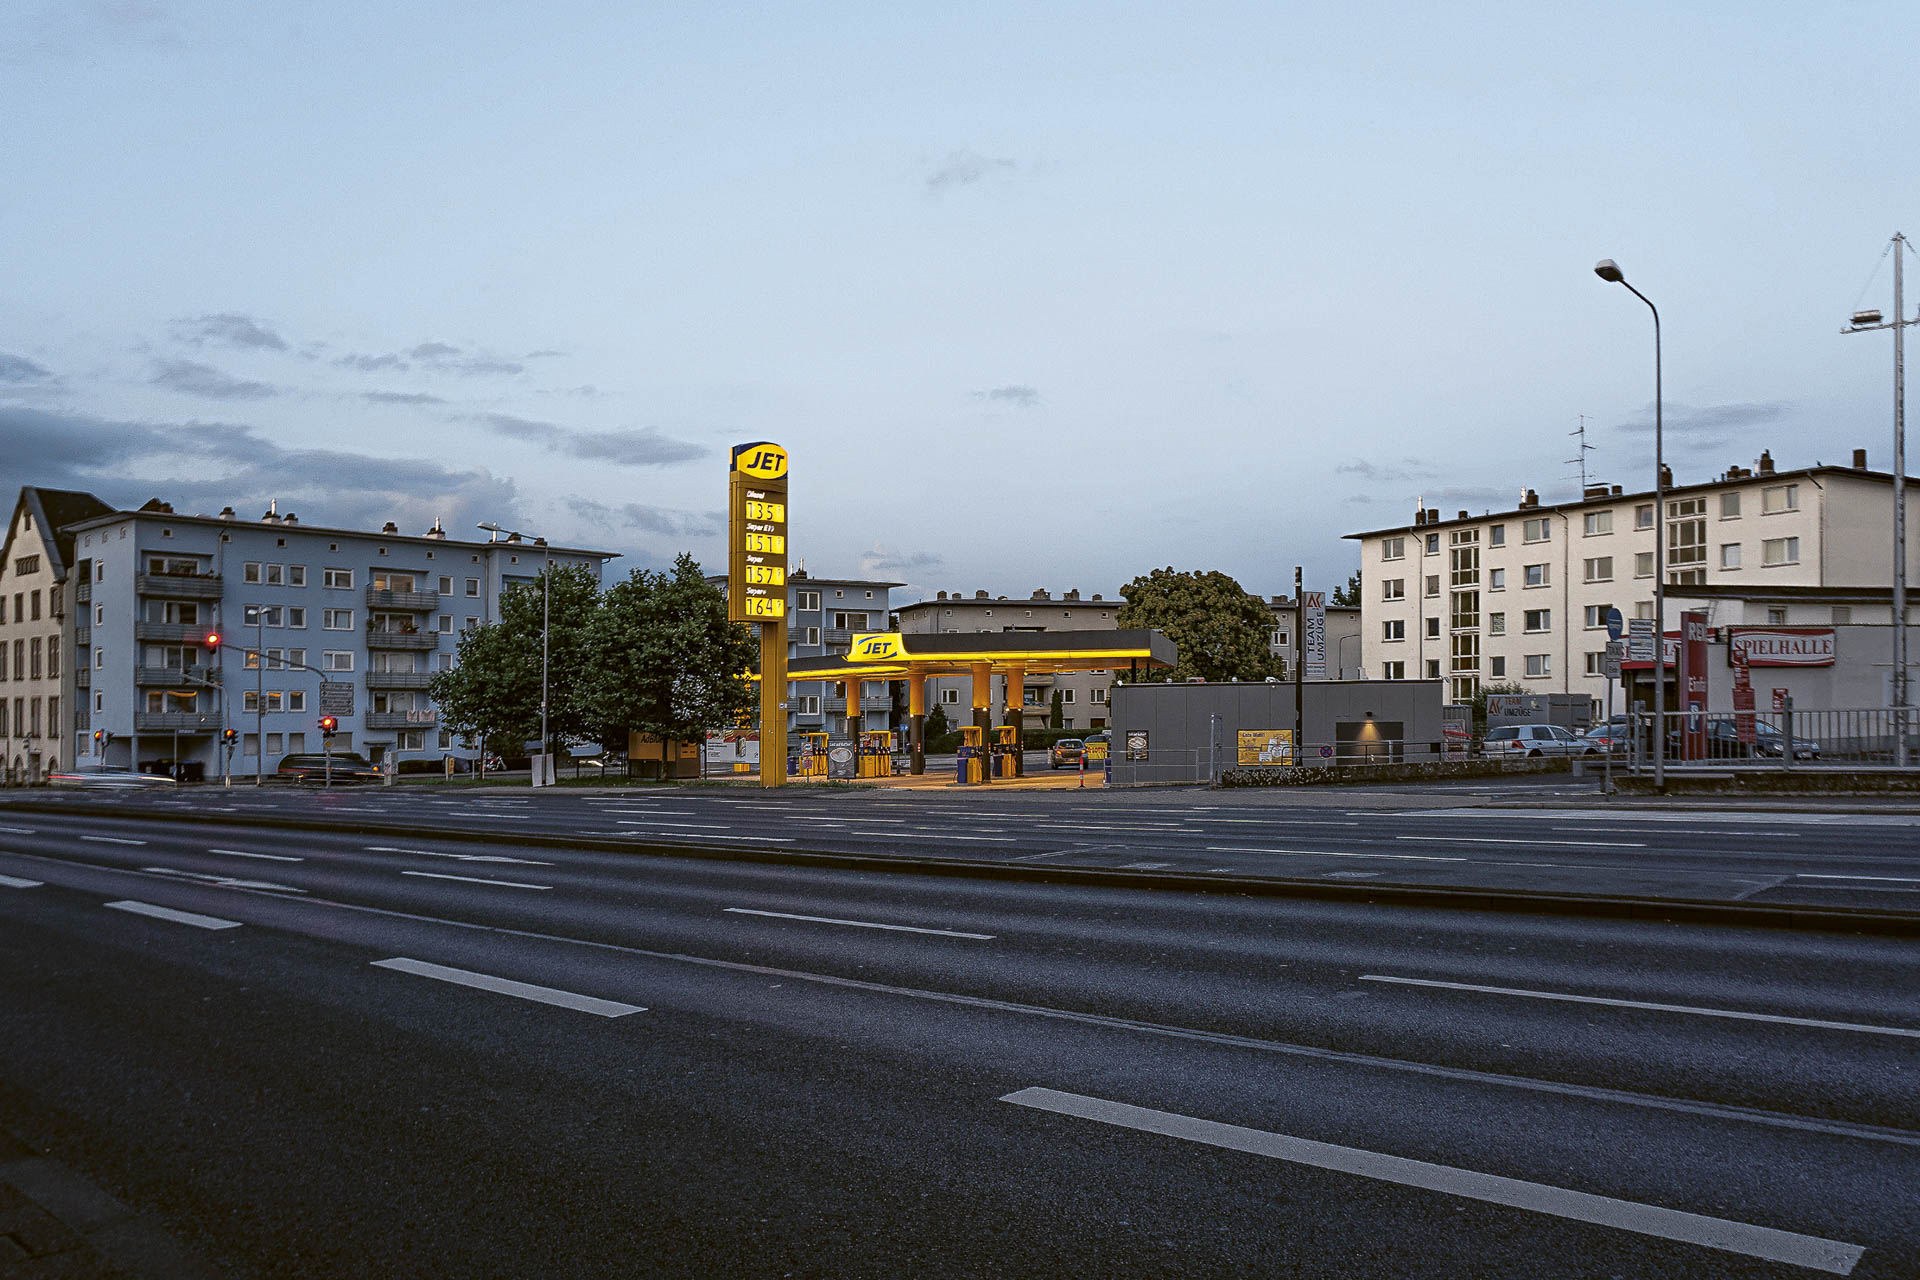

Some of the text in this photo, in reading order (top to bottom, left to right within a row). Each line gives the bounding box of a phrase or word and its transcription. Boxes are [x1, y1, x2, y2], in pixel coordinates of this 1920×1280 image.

[747, 451, 785, 471] JET
[747, 502, 773, 520] 135
[746, 523, 763, 532] Super
[747, 534, 772, 552] 151
[747, 566, 773, 584] 157
[747, 598, 773, 615] 164
[1307, 618, 1315, 654] TEAM
[1315, 610, 1324, 661] UMZÜGE
[863, 643, 892, 655] JET
[1734, 639, 1832, 655] SPIELHALLE
[1505, 696, 1522, 705] TEAM
